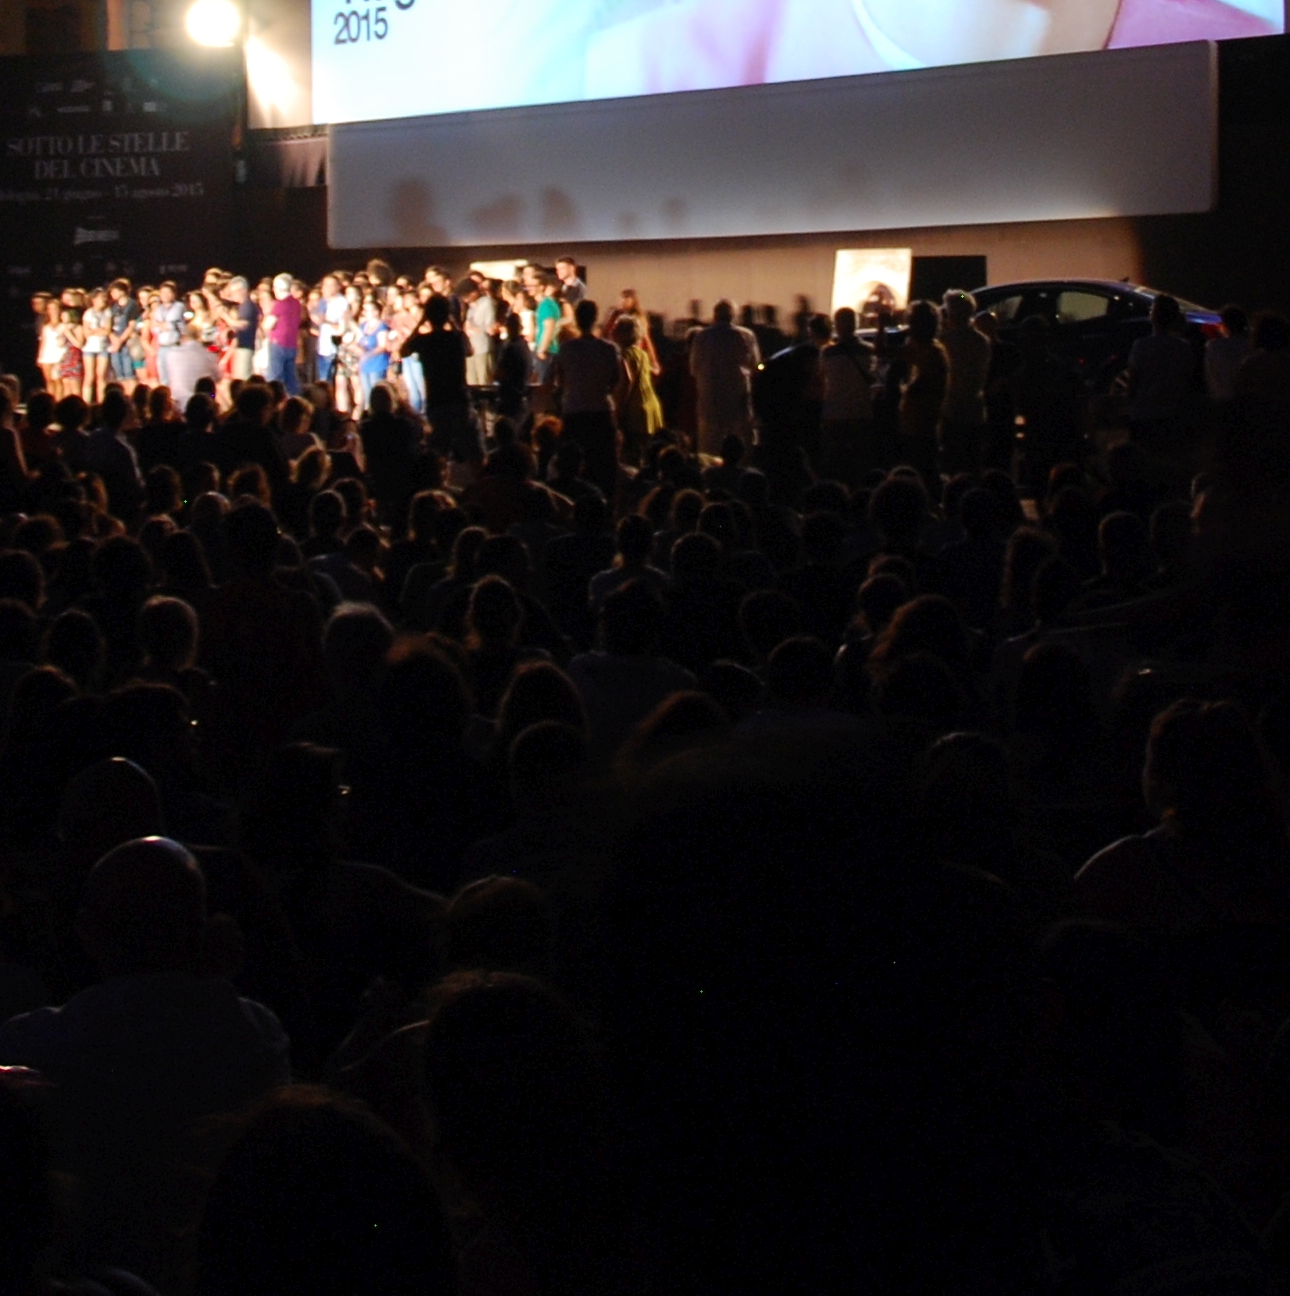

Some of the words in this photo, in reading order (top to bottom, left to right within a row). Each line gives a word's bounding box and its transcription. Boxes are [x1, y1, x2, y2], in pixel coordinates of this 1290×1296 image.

[333, 6, 389, 45] 2015
[6, 135, 73, 157] SOTTO
[76, 134, 105, 155] LE
[109, 130, 191, 152] STELLE
[33, 159, 76, 180] DEL
[79, 156, 161, 177] CINEMA
